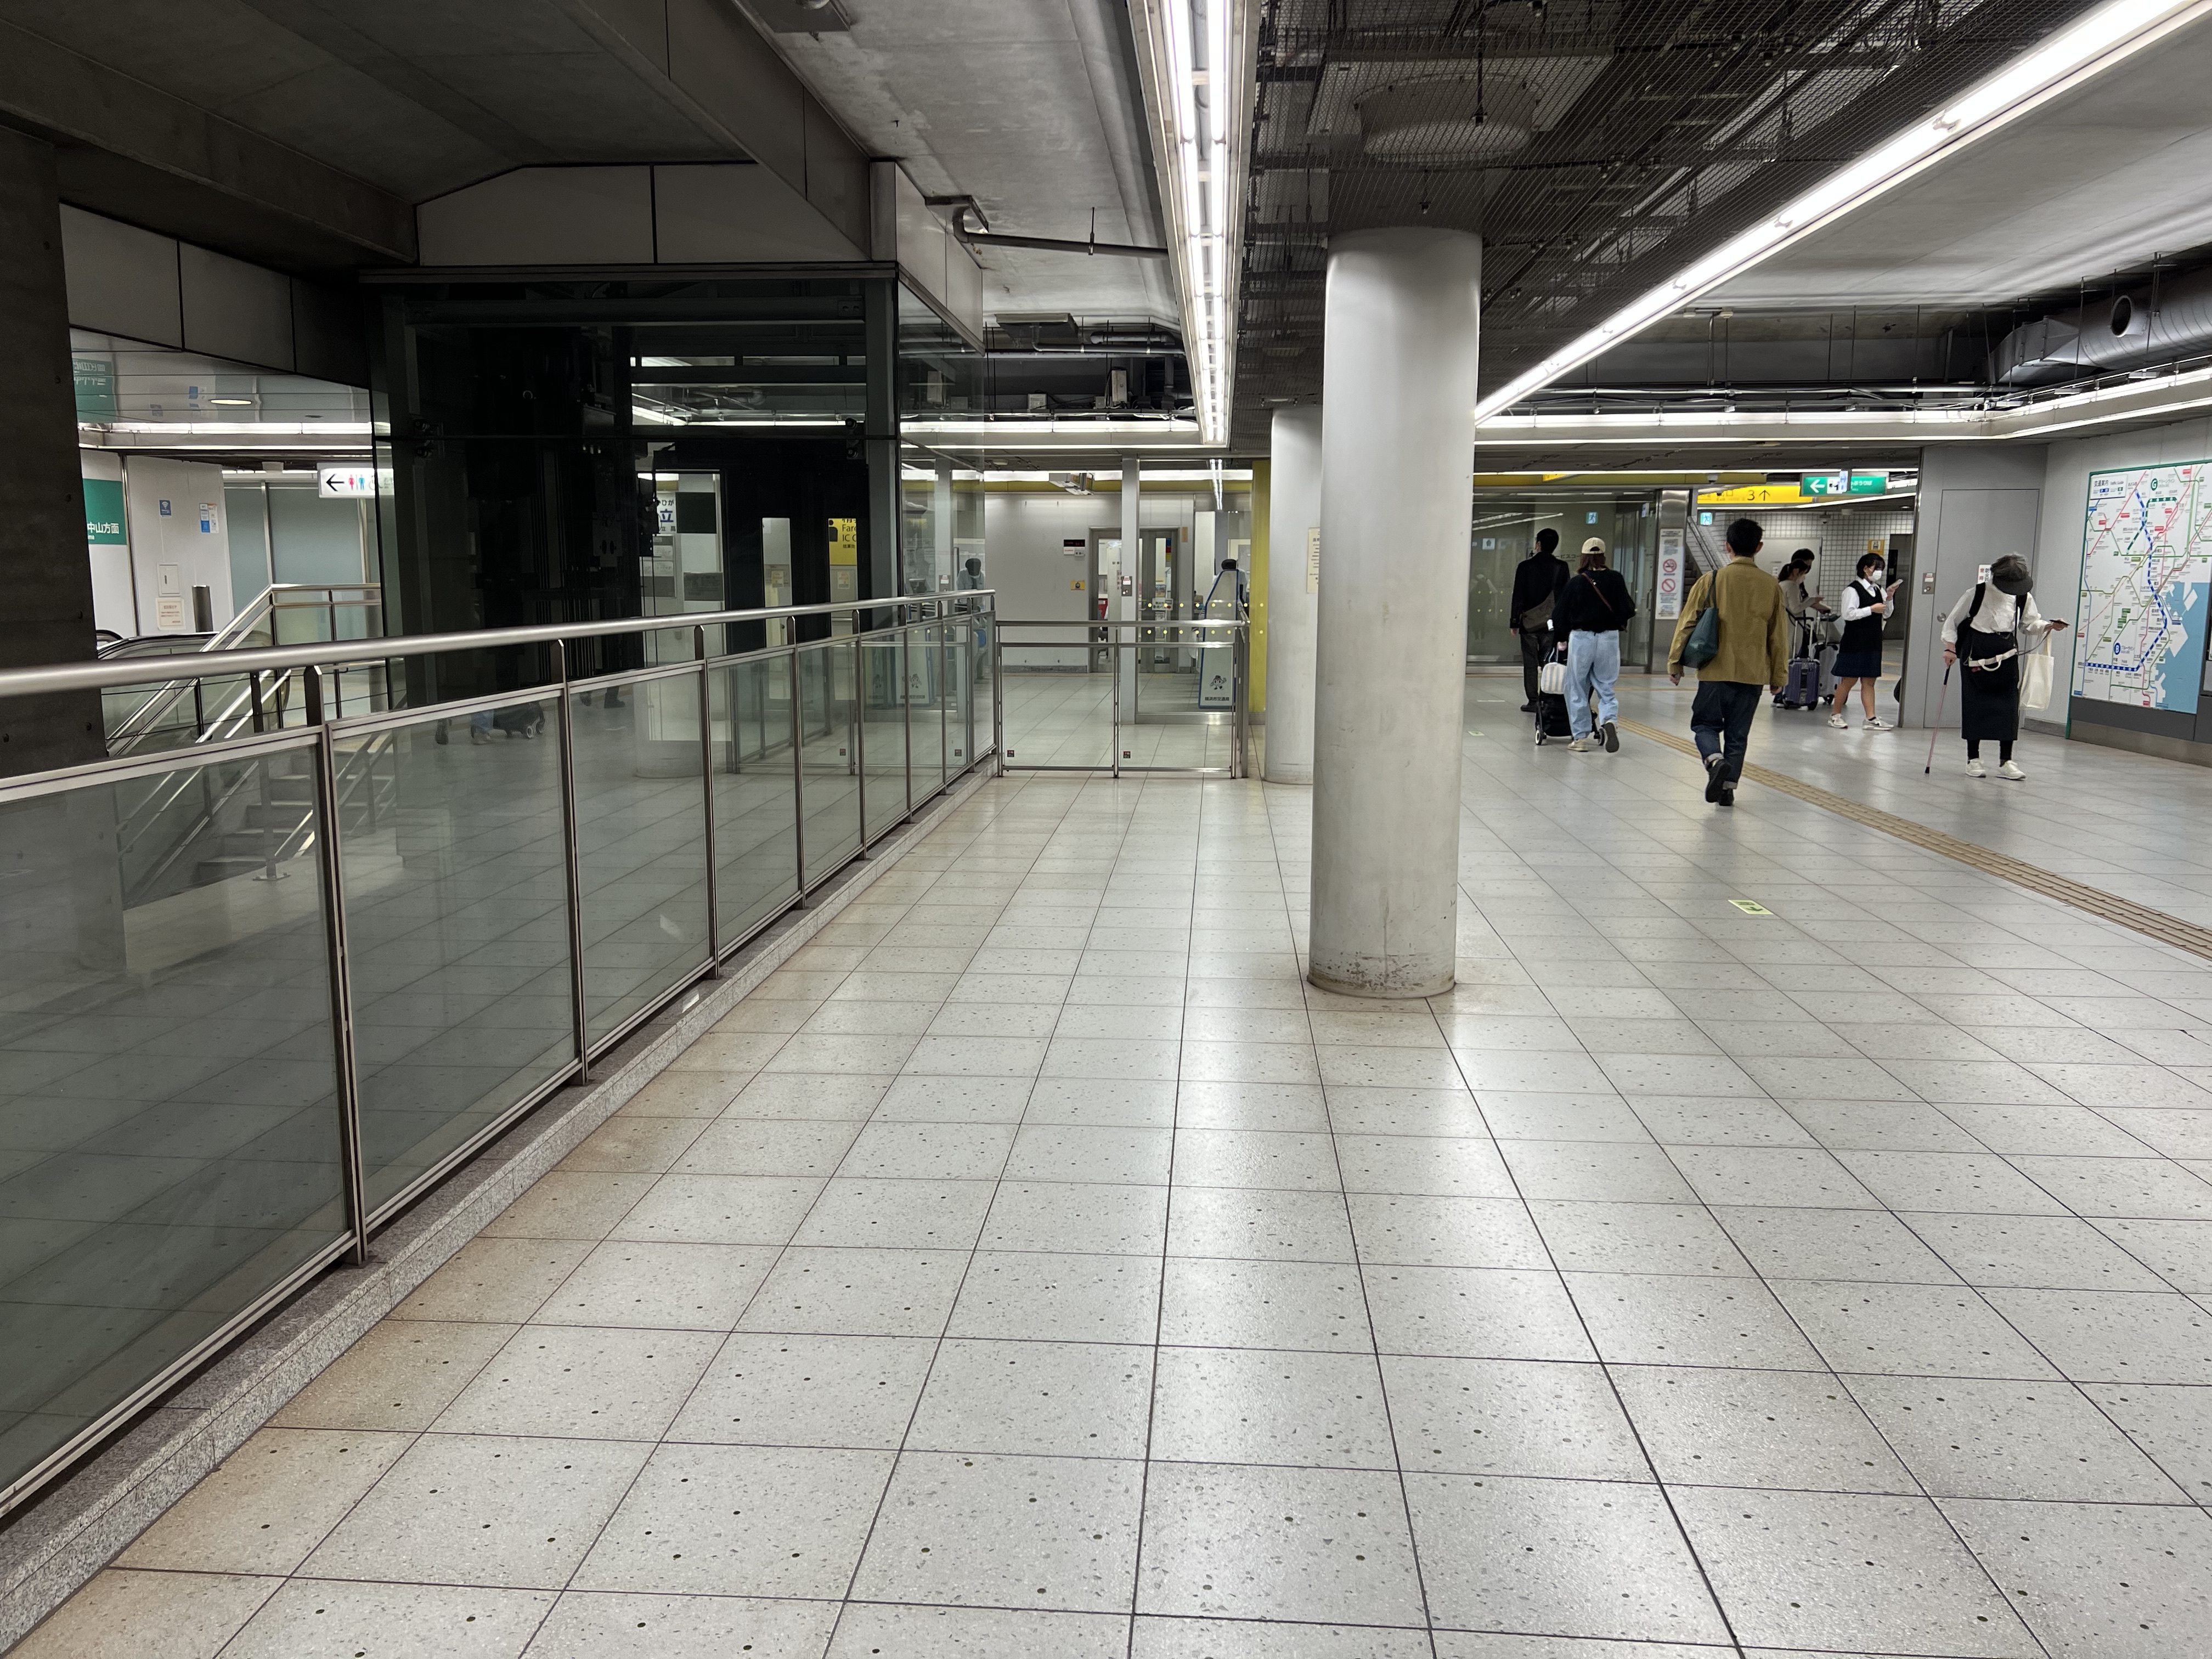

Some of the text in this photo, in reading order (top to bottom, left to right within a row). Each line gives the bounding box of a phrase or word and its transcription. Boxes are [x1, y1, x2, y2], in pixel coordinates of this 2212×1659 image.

[2152, 480, 2157, 489] G
[1747, 490, 1755, 501] 3
[660, 509, 674, 522] 立
[87, 521, 120, 534] 中山方面
